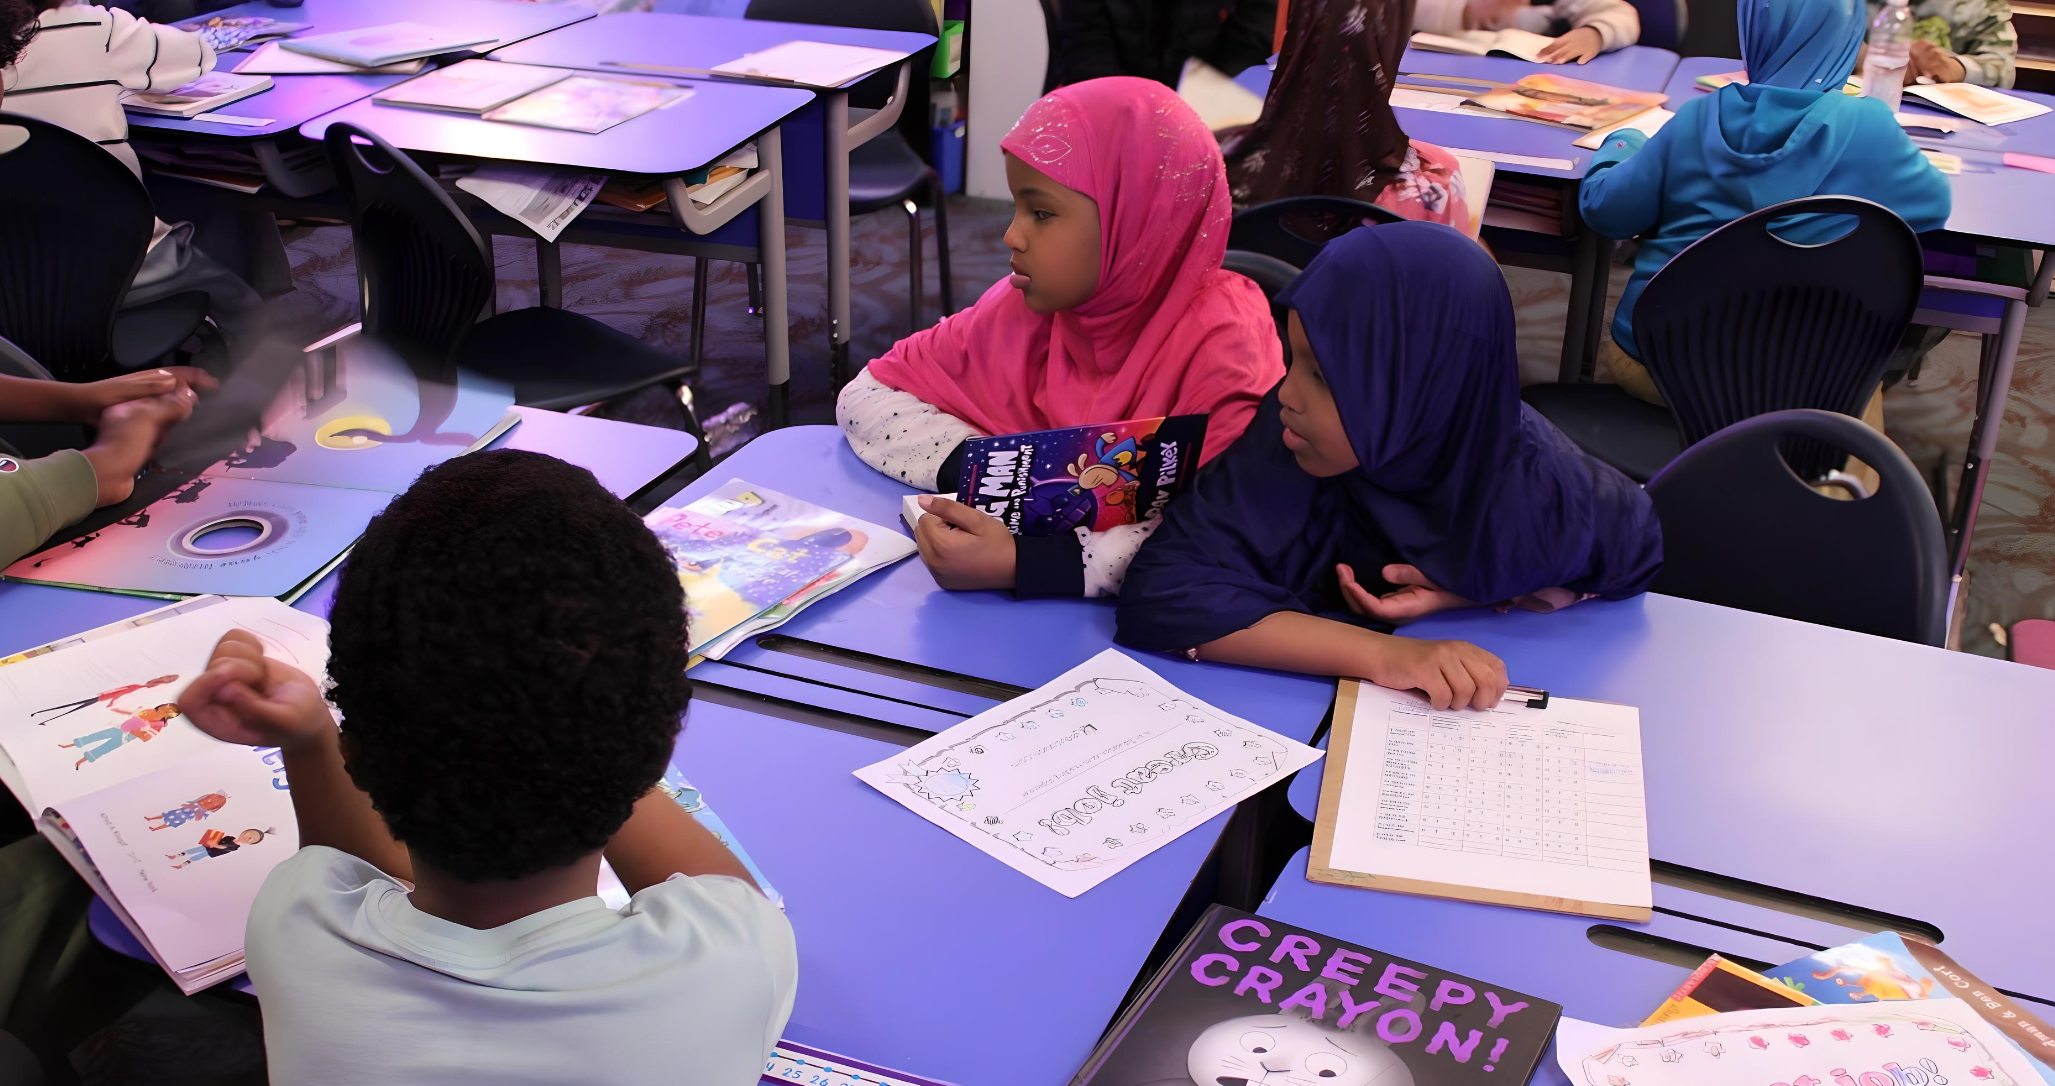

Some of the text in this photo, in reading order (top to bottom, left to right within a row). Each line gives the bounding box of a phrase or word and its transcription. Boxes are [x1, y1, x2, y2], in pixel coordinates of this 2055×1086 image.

[975, 450, 1020, 523] G MAN
[673, 513, 724, 539] Pete
[1111, 741, 1220, 795] Great
[1038, 784, 1125, 836] job!
[1217, 918, 1531, 1029] CREEPY
[1190, 952, 1511, 1073] CRAYON!
[781, 1067, 804, 1079] 25
[809, 1074, 830, 1086] 26
